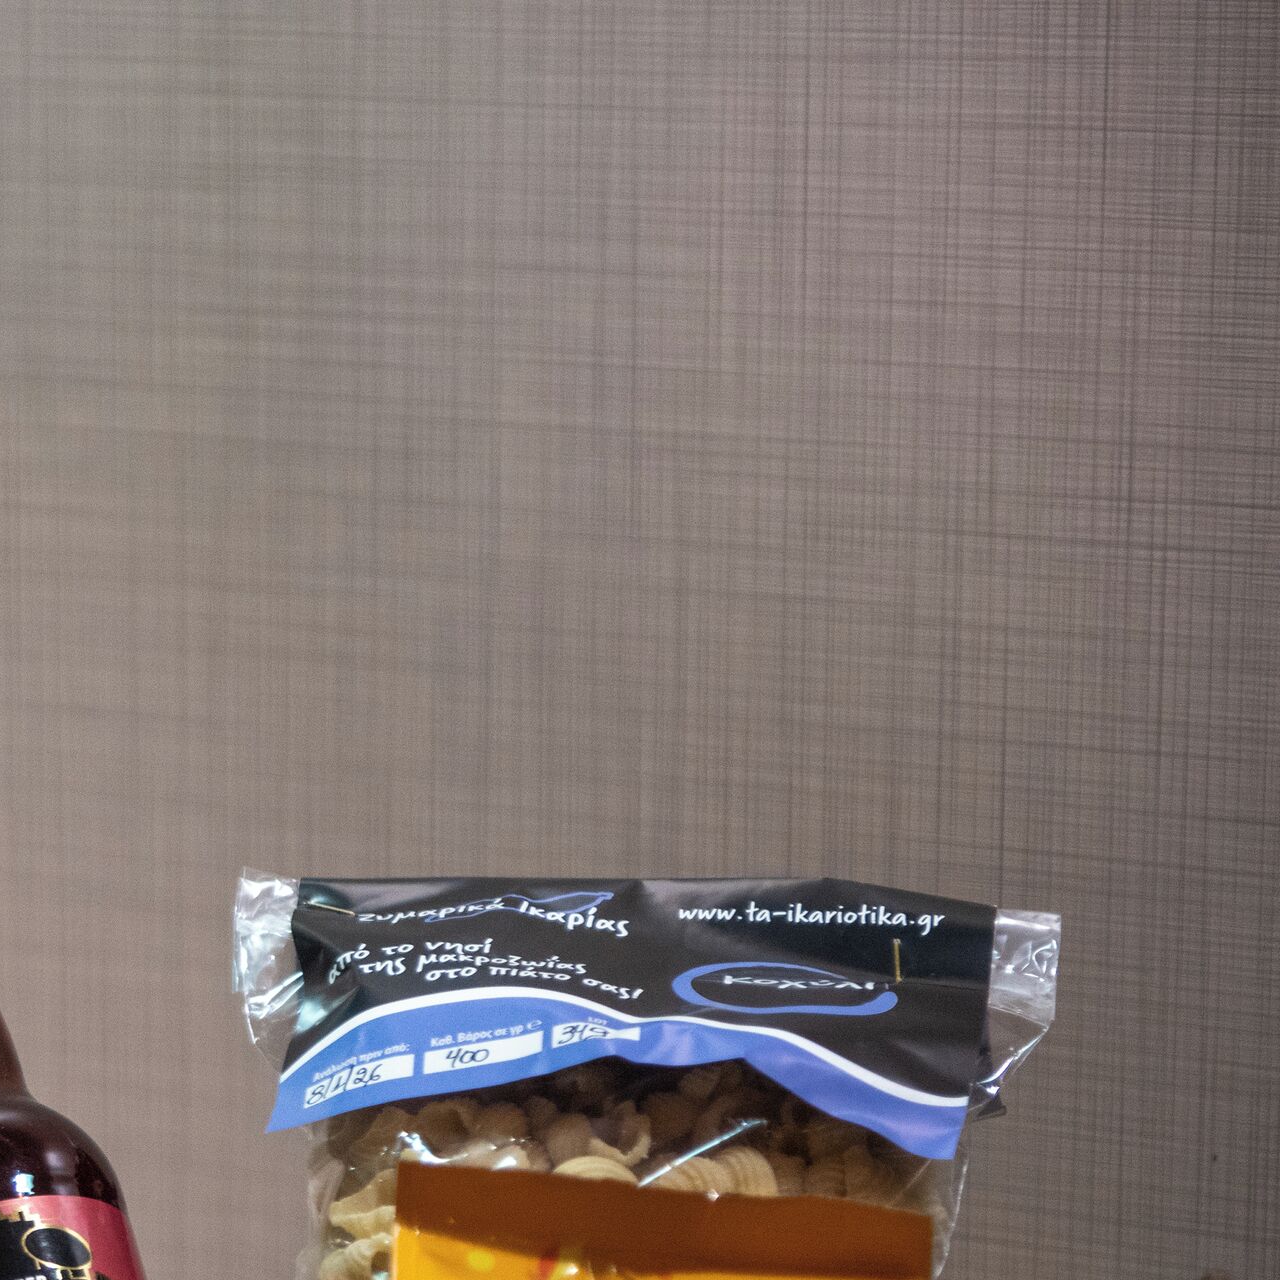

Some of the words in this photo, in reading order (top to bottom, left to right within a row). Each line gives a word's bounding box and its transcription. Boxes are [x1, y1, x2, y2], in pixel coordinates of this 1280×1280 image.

[519, 900, 630, 938] Ικαρίας
[678, 901, 945, 937] www.ta-ikariotika.gr
[381, 943, 415, 955] το
[424, 938, 493, 955] νησί
[359, 957, 407, 976] της
[425, 966, 478, 981] στο
[488, 966, 572, 981] πιάτο
[446, 1048, 490, 1068] 400
